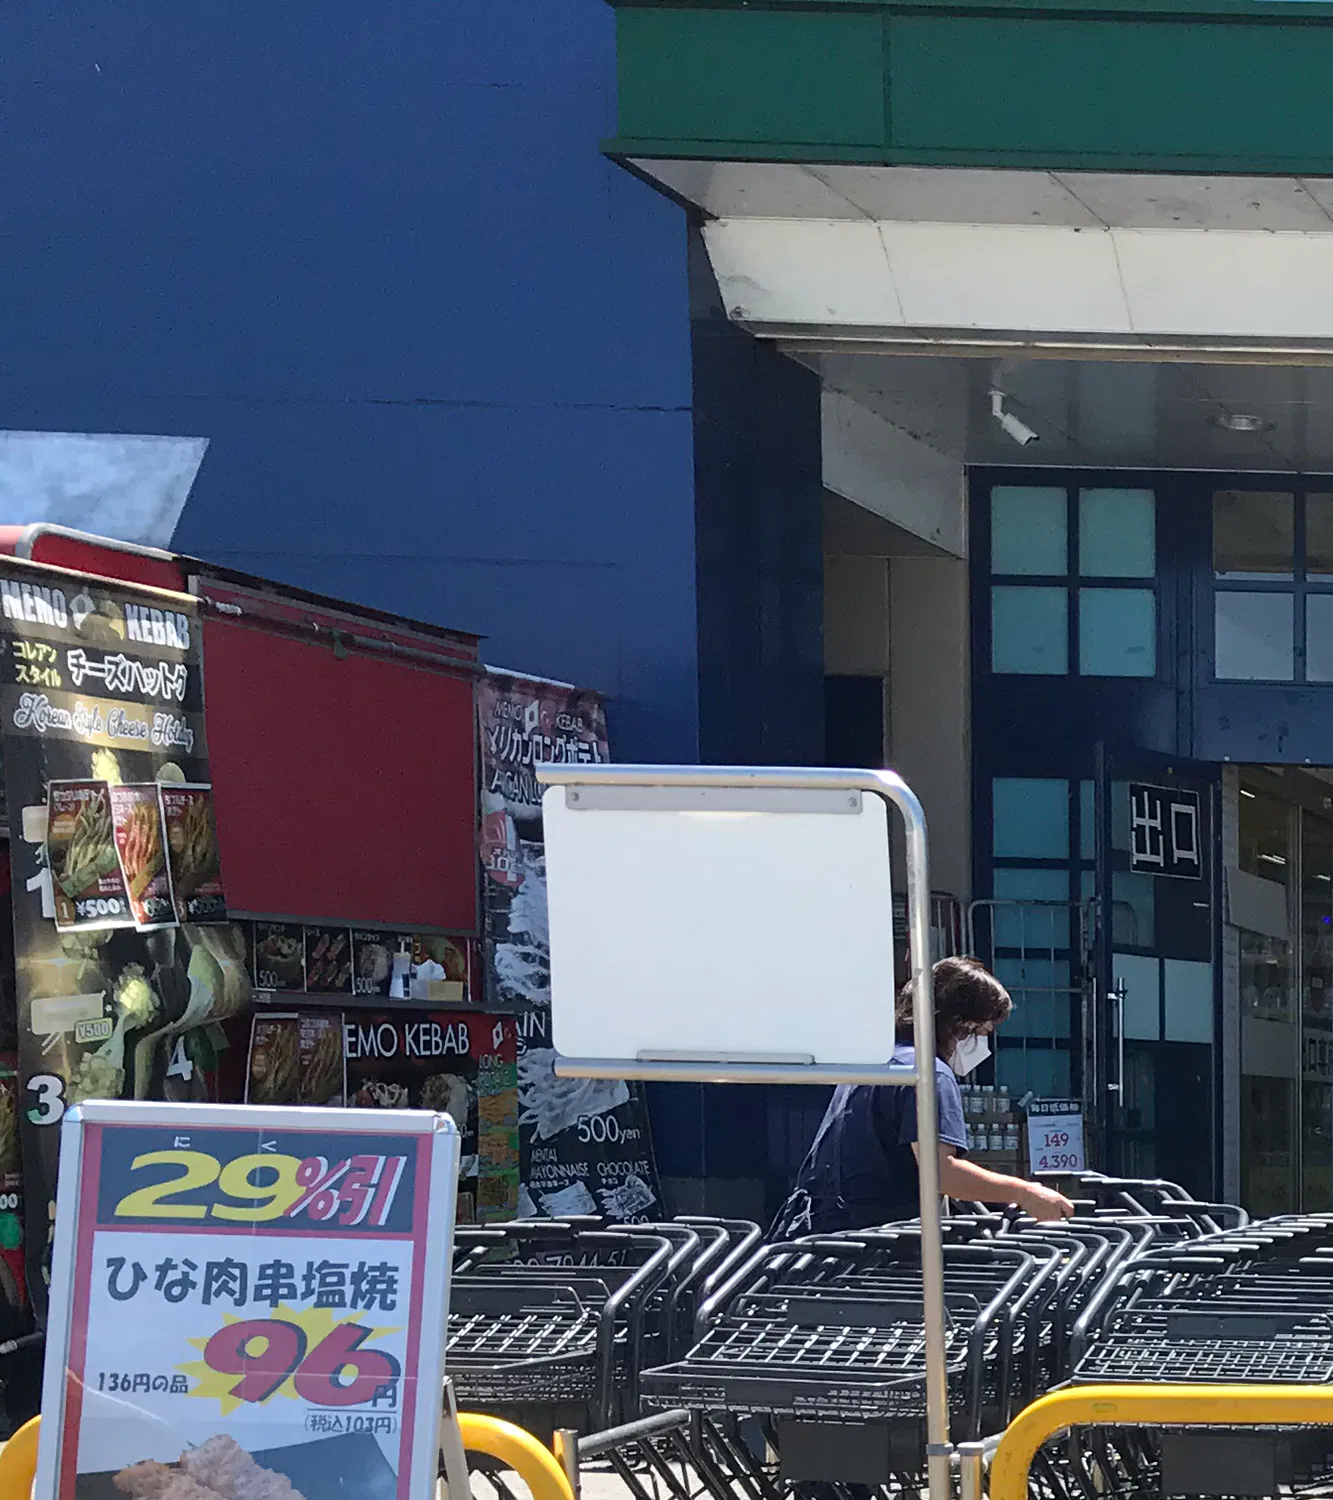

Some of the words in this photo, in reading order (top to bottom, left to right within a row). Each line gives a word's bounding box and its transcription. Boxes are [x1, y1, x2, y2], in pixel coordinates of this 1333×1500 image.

[124, 602, 191, 651] KEBAB
[12, 641, 58, 663] コレアン
[15, 664, 63, 687] スタイル
[66, 647, 188, 702] チーズハットグ
[13, 692, 72, 733] Korean
[72, 701, 103, 740] Style
[106, 707, 149, 740] Cheese
[1130, 790, 1200, 868] 出口
[346, 1023, 399, 1058] EMO
[405, 1023, 470, 1056] KEBAB
[166, 1036, 194, 1082] 4
[26, 1074, 67, 1126] 3
[173, 1135, 191, 1148] に
[260, 1140, 278, 1153] く
[1044, 1132, 1070, 1147] 149
[596, 1159, 651, 1177] CHOCOLATE
[105, 1256, 400, 1311] ひな肉串塩焼
[98, 1371, 189, 1394] 136円の品
[304, 1413, 398, 1434] (税込103円)
